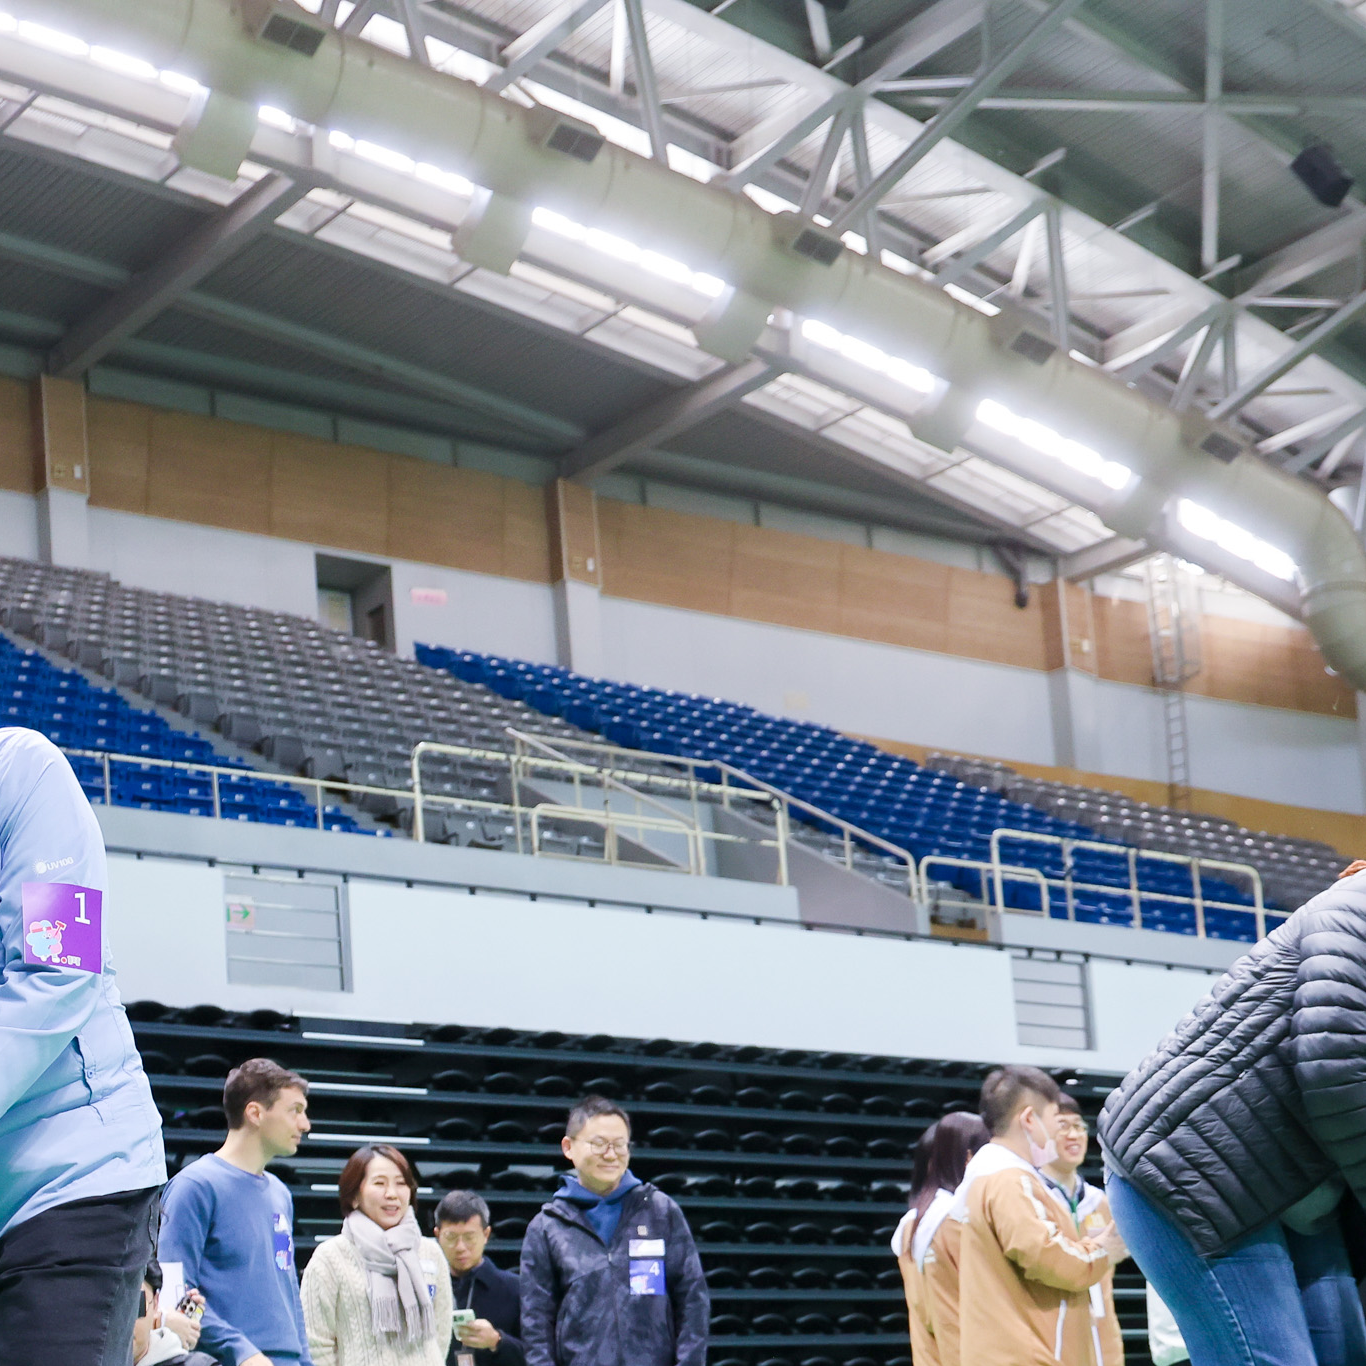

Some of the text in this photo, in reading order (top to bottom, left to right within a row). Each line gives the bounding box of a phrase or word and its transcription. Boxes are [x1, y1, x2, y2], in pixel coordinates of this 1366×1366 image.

[46, 856, 74, 871] UV100
[74, 892, 91, 925] 1
[649, 1261, 660, 1276] 4
